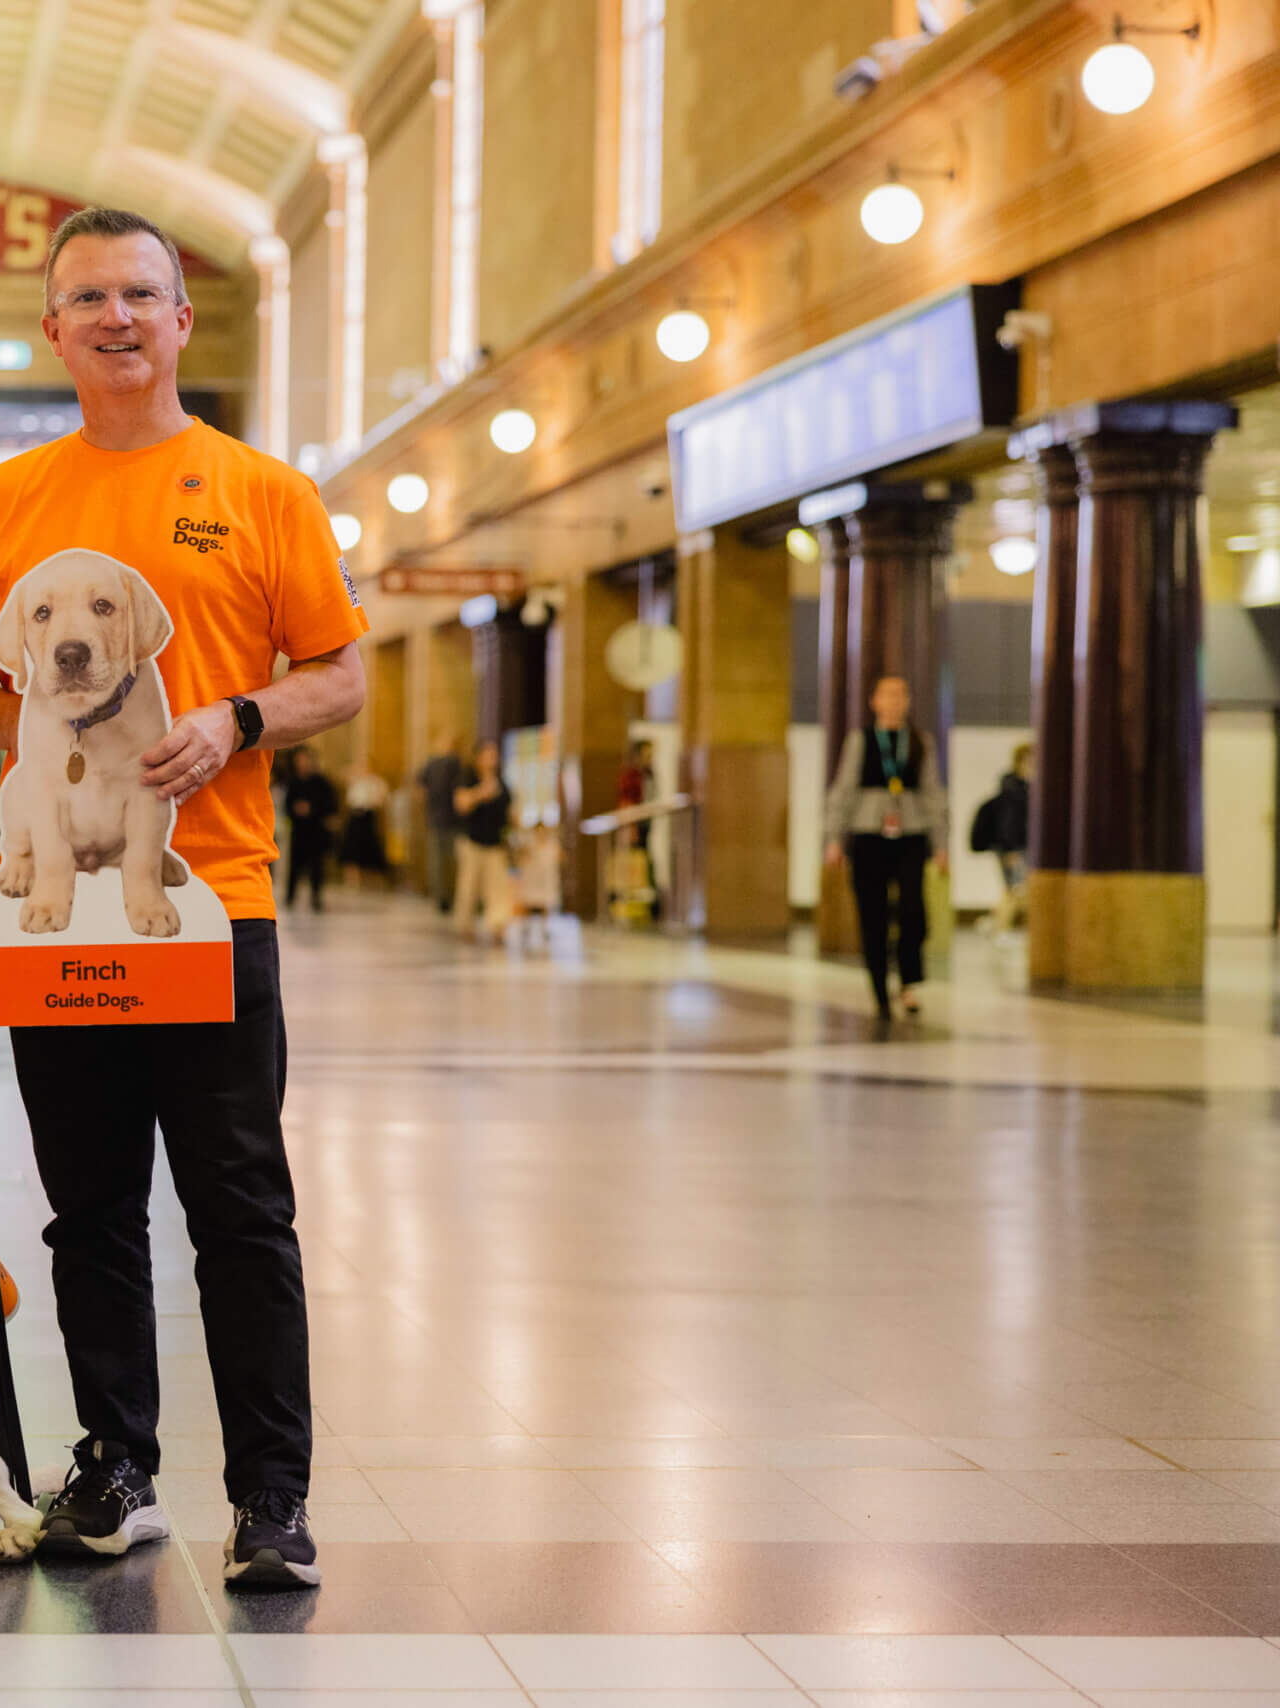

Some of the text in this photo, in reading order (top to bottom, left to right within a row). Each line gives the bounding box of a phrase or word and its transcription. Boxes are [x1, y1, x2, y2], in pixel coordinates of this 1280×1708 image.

[175, 517, 230, 536] Guide
[173, 531, 224, 553] Dogs.
[61, 960, 127, 981] Finch
[45, 992, 144, 1012] Guide Dogs.
